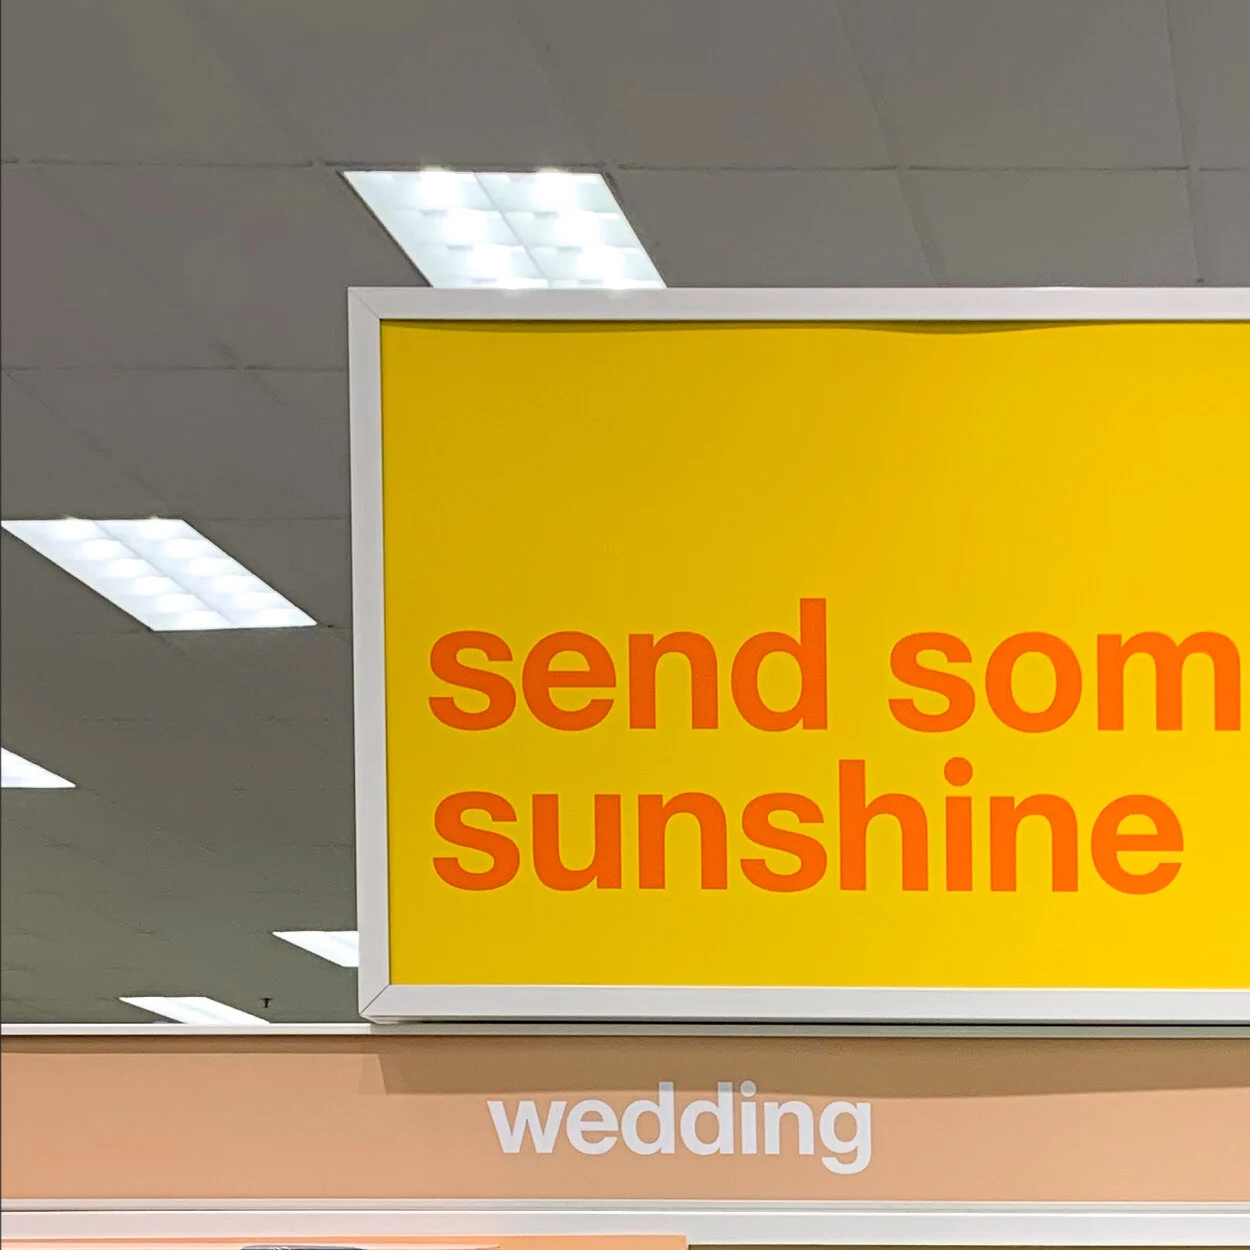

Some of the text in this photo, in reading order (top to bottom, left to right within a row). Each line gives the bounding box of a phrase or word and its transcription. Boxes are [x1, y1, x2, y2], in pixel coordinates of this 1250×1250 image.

[427, 597, 829, 732] send
[431, 756, 1185, 895] sunshine
[487, 1081, 875, 1174] wedding
